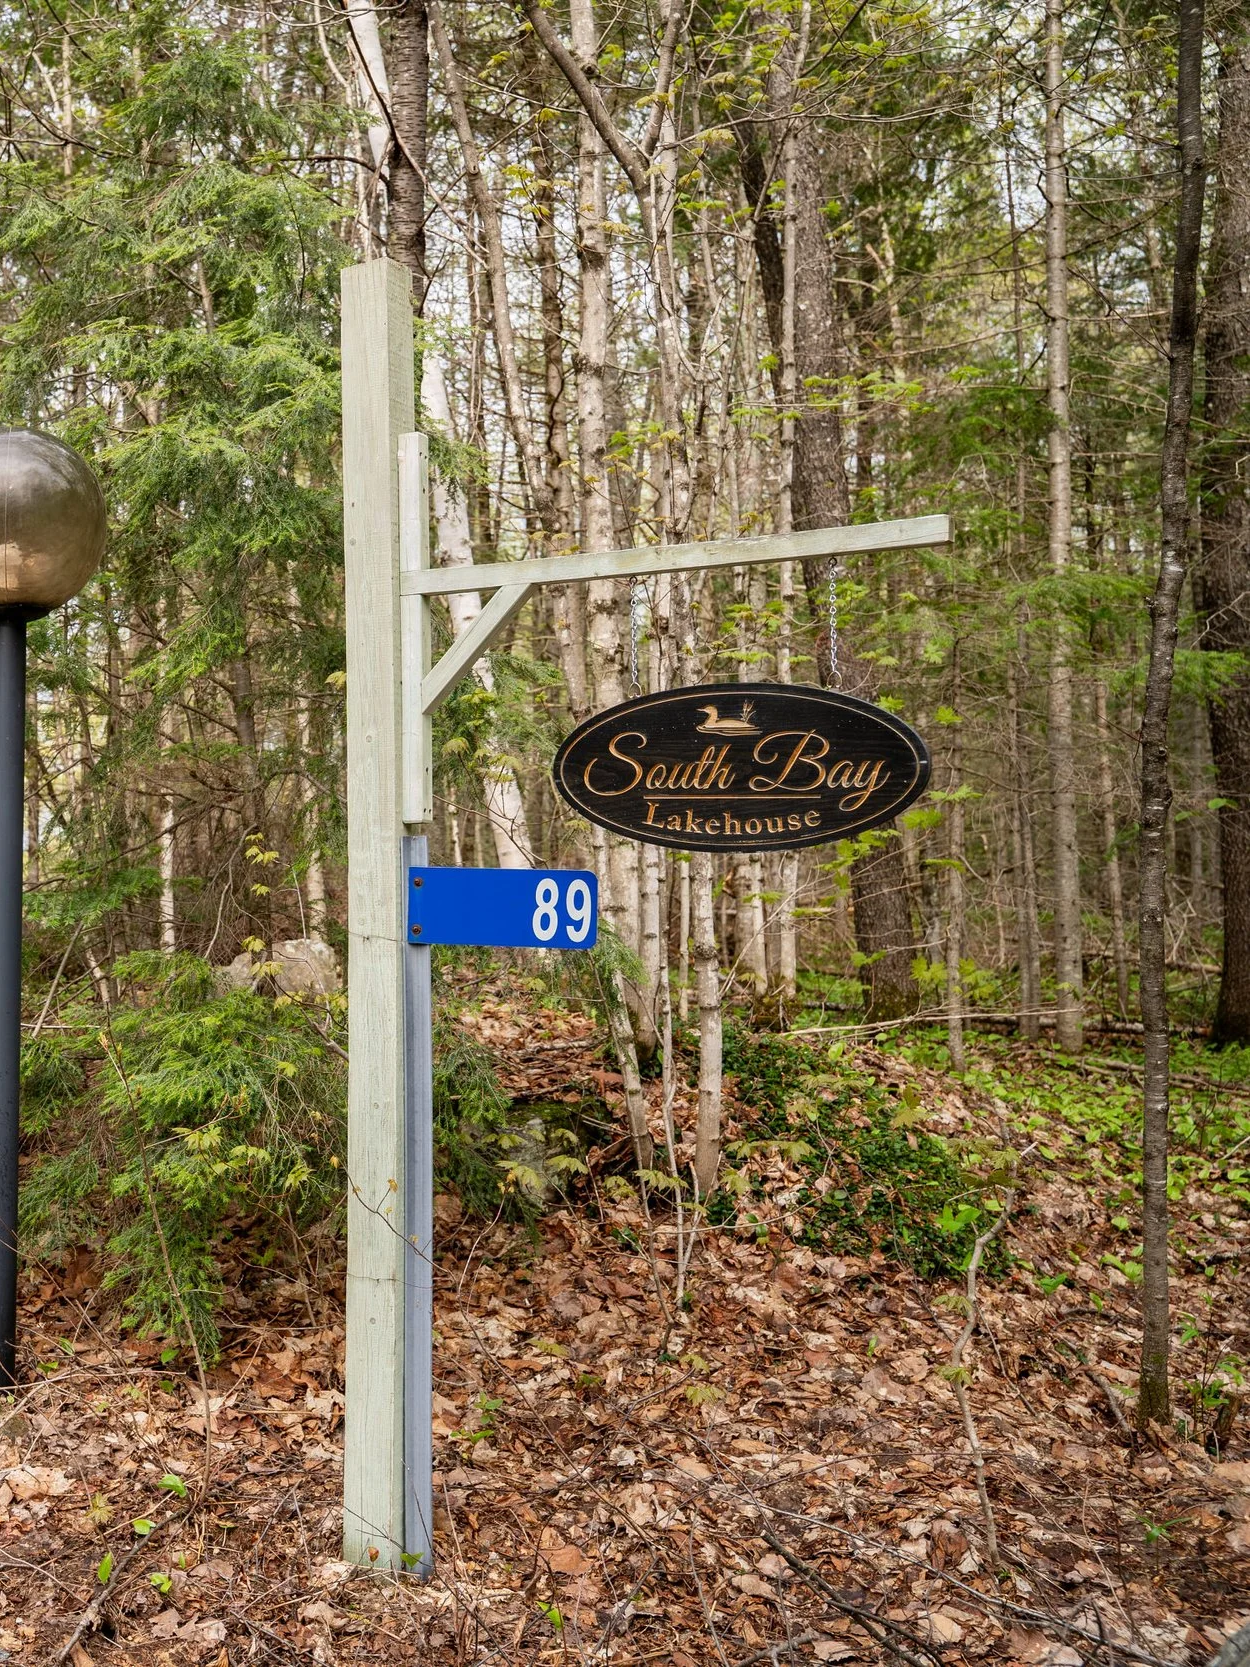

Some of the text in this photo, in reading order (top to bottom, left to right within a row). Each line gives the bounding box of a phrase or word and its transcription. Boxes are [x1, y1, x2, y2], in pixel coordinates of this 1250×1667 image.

[584, 729, 891, 812] South Bay
[642, 801, 822, 835] Lakehouse
[532, 878, 593, 943] 89
